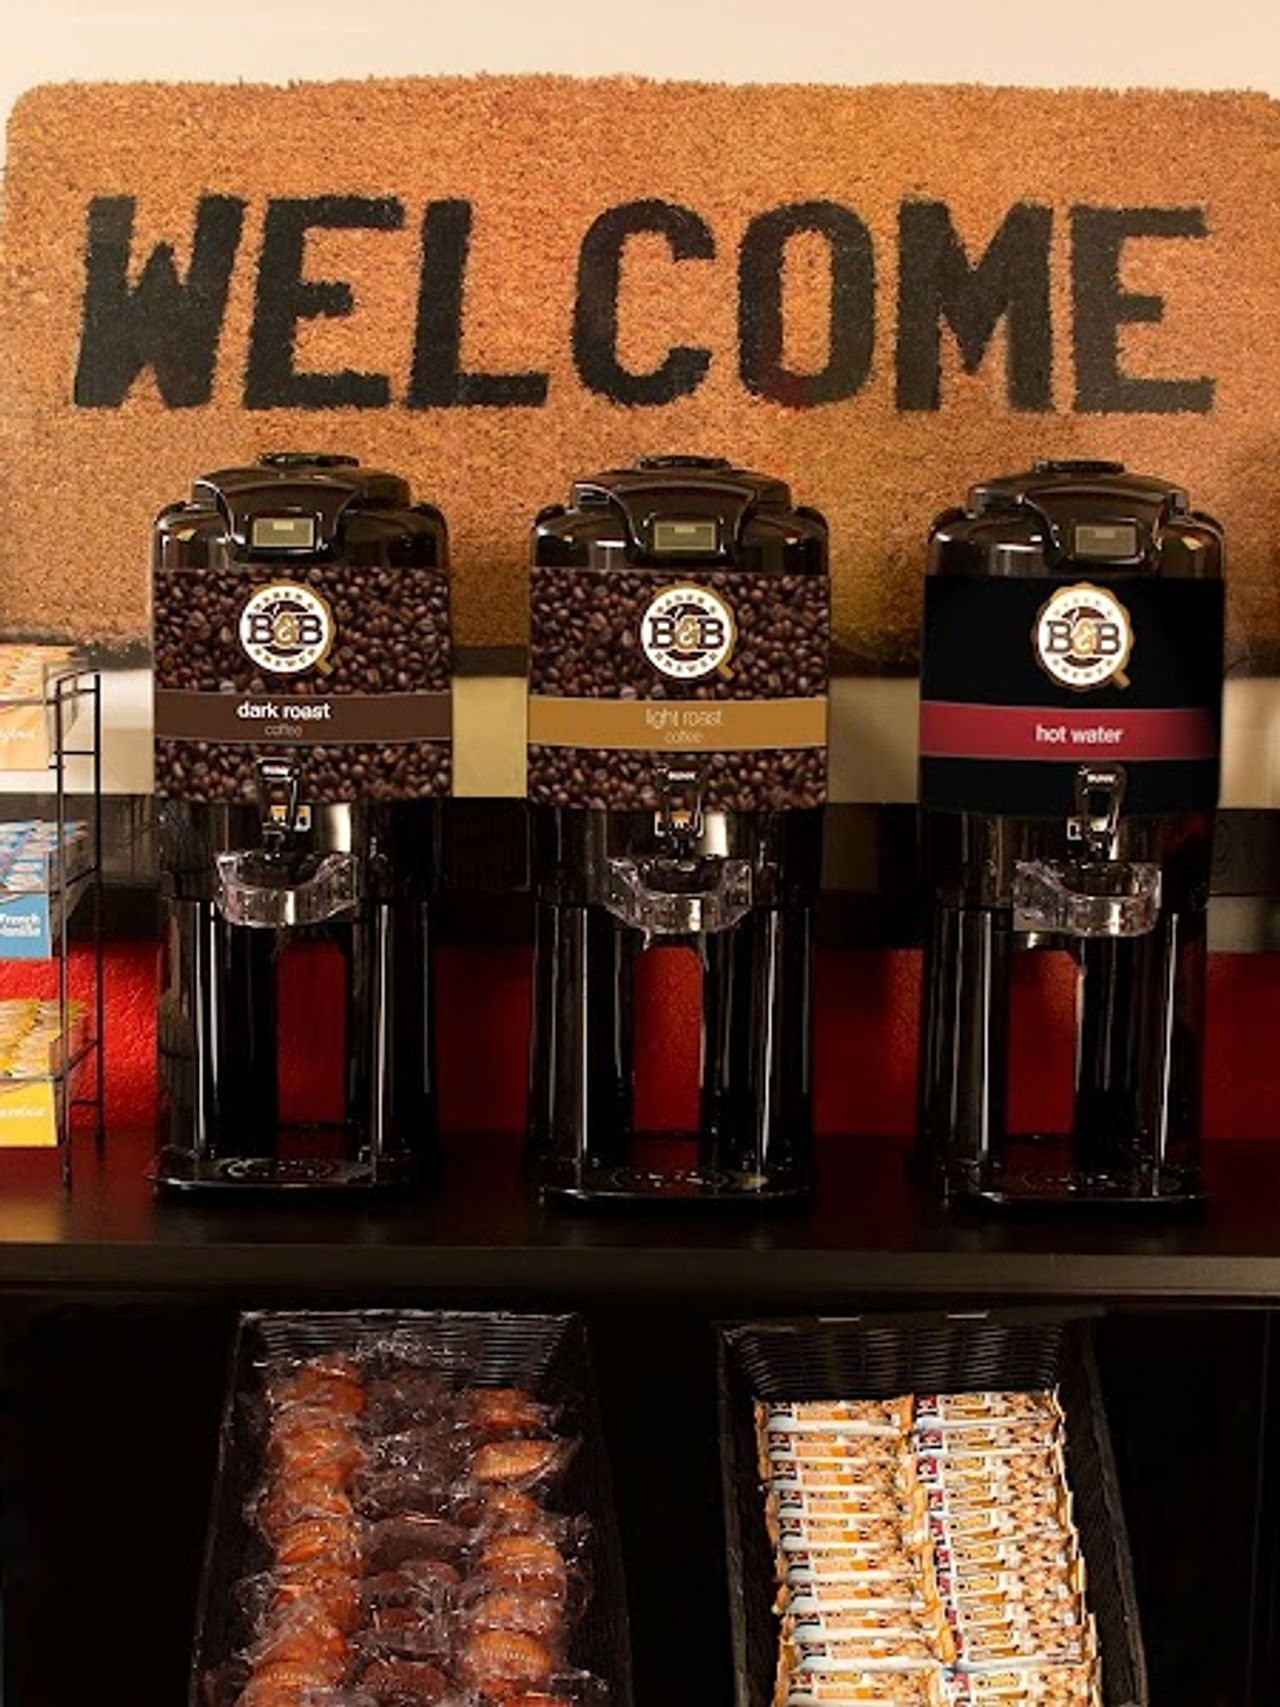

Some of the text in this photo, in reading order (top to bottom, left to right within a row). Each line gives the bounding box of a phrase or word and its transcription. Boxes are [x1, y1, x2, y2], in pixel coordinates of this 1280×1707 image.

[73, 195, 1214, 413] WELCOME
[247, 611, 323, 647] B&B
[649, 614, 725, 651] B&B
[237, 701, 331, 720] dark roast
[645, 708, 722, 730] light roast
[264, 724, 303, 738] coffee
[664, 730, 704, 743] coffee
[1035, 723, 1123, 744] hot water
